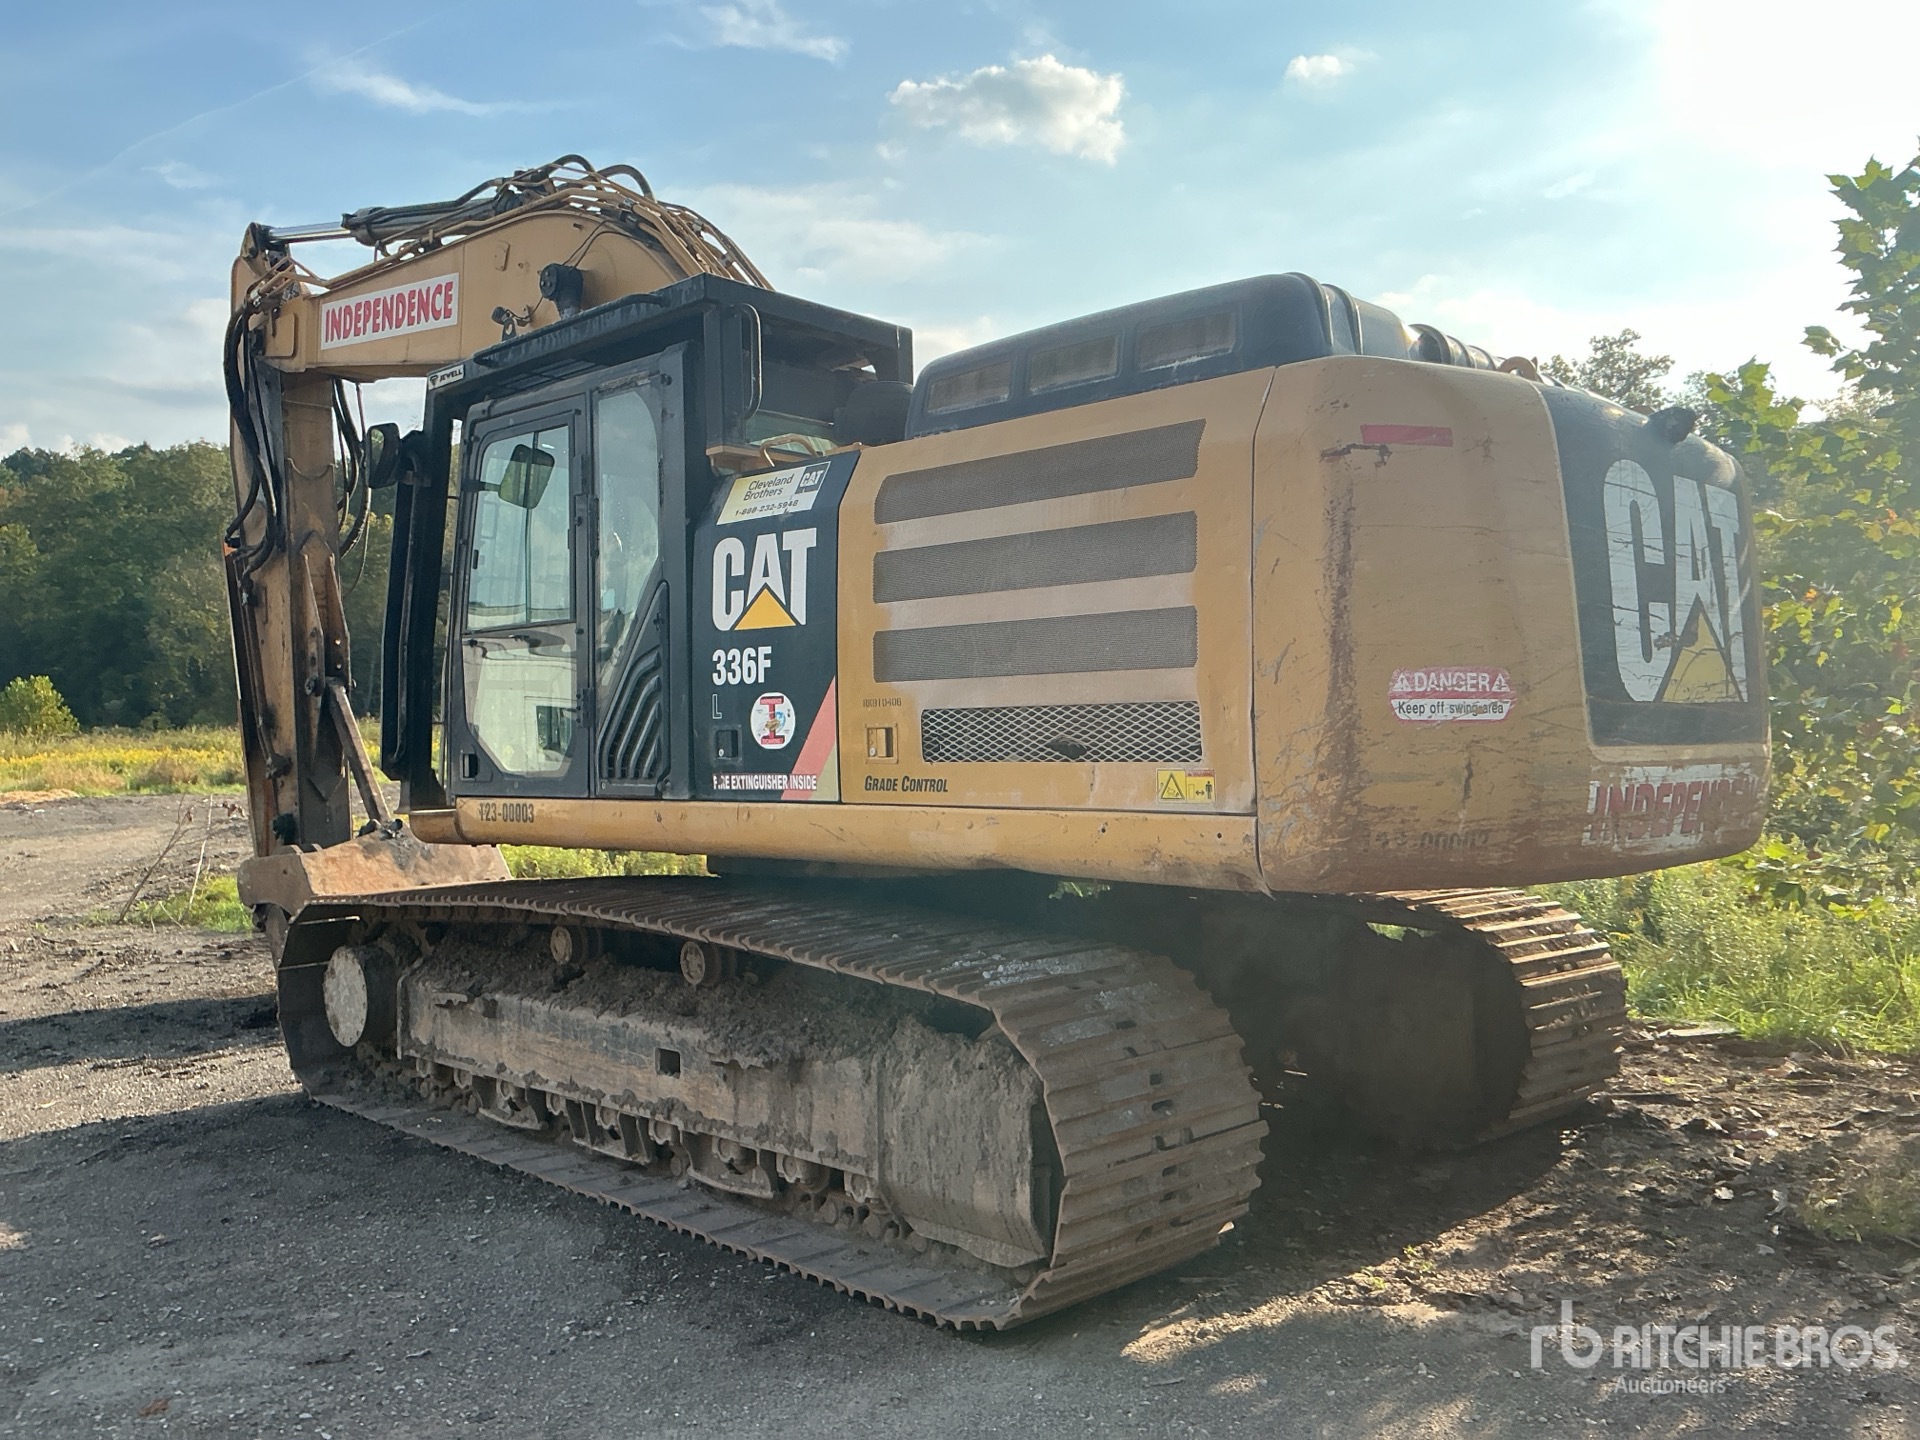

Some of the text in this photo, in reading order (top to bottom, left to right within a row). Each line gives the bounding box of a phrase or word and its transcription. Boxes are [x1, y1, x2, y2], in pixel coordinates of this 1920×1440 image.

[325, 281, 454, 343] INDEPENDENCE
[439, 369, 463, 382] JEWELL
[748, 473, 794, 491] Cleveland
[800, 470, 825, 488] CAT
[743, 487, 784, 501] Brothers
[712, 527, 817, 632] CAT
[1603, 459, 1749, 702] CAT
[712, 645, 772, 686] 336F
[1414, 672, 1490, 692] DANGER
[1398, 701, 1504, 717] Keep off swing area
[713, 774, 817, 790] FRE EXTINGUISHER INSIDE
[864, 775, 949, 793] GRADE CONTROL
